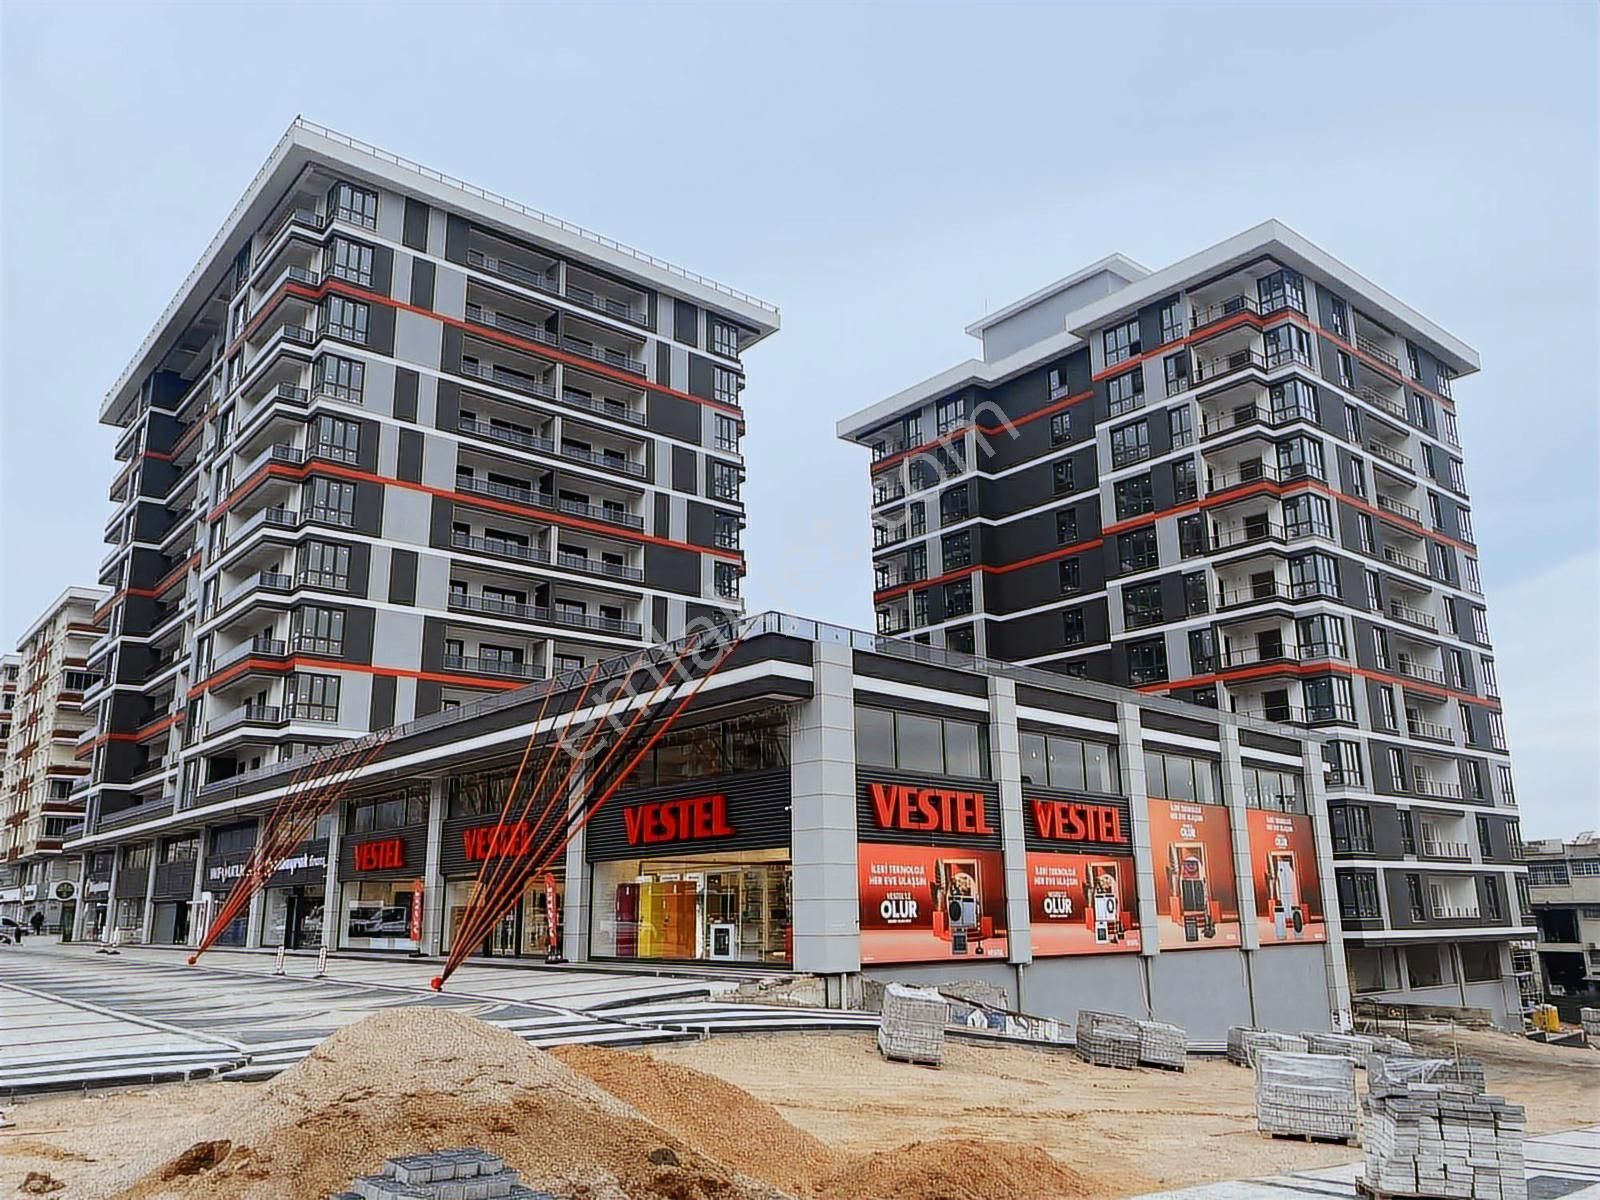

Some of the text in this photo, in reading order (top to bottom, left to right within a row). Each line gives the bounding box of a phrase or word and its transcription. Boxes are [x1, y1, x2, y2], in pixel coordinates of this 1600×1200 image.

[624, 794, 736, 846] VESTEL
[870, 783, 994, 836] VESTEL
[1033, 799, 1129, 844] VESTEL
[353, 838, 406, 871] VESTEL
[880, 900, 918, 919] OLUR
[1044, 898, 1072, 914] OLUR
